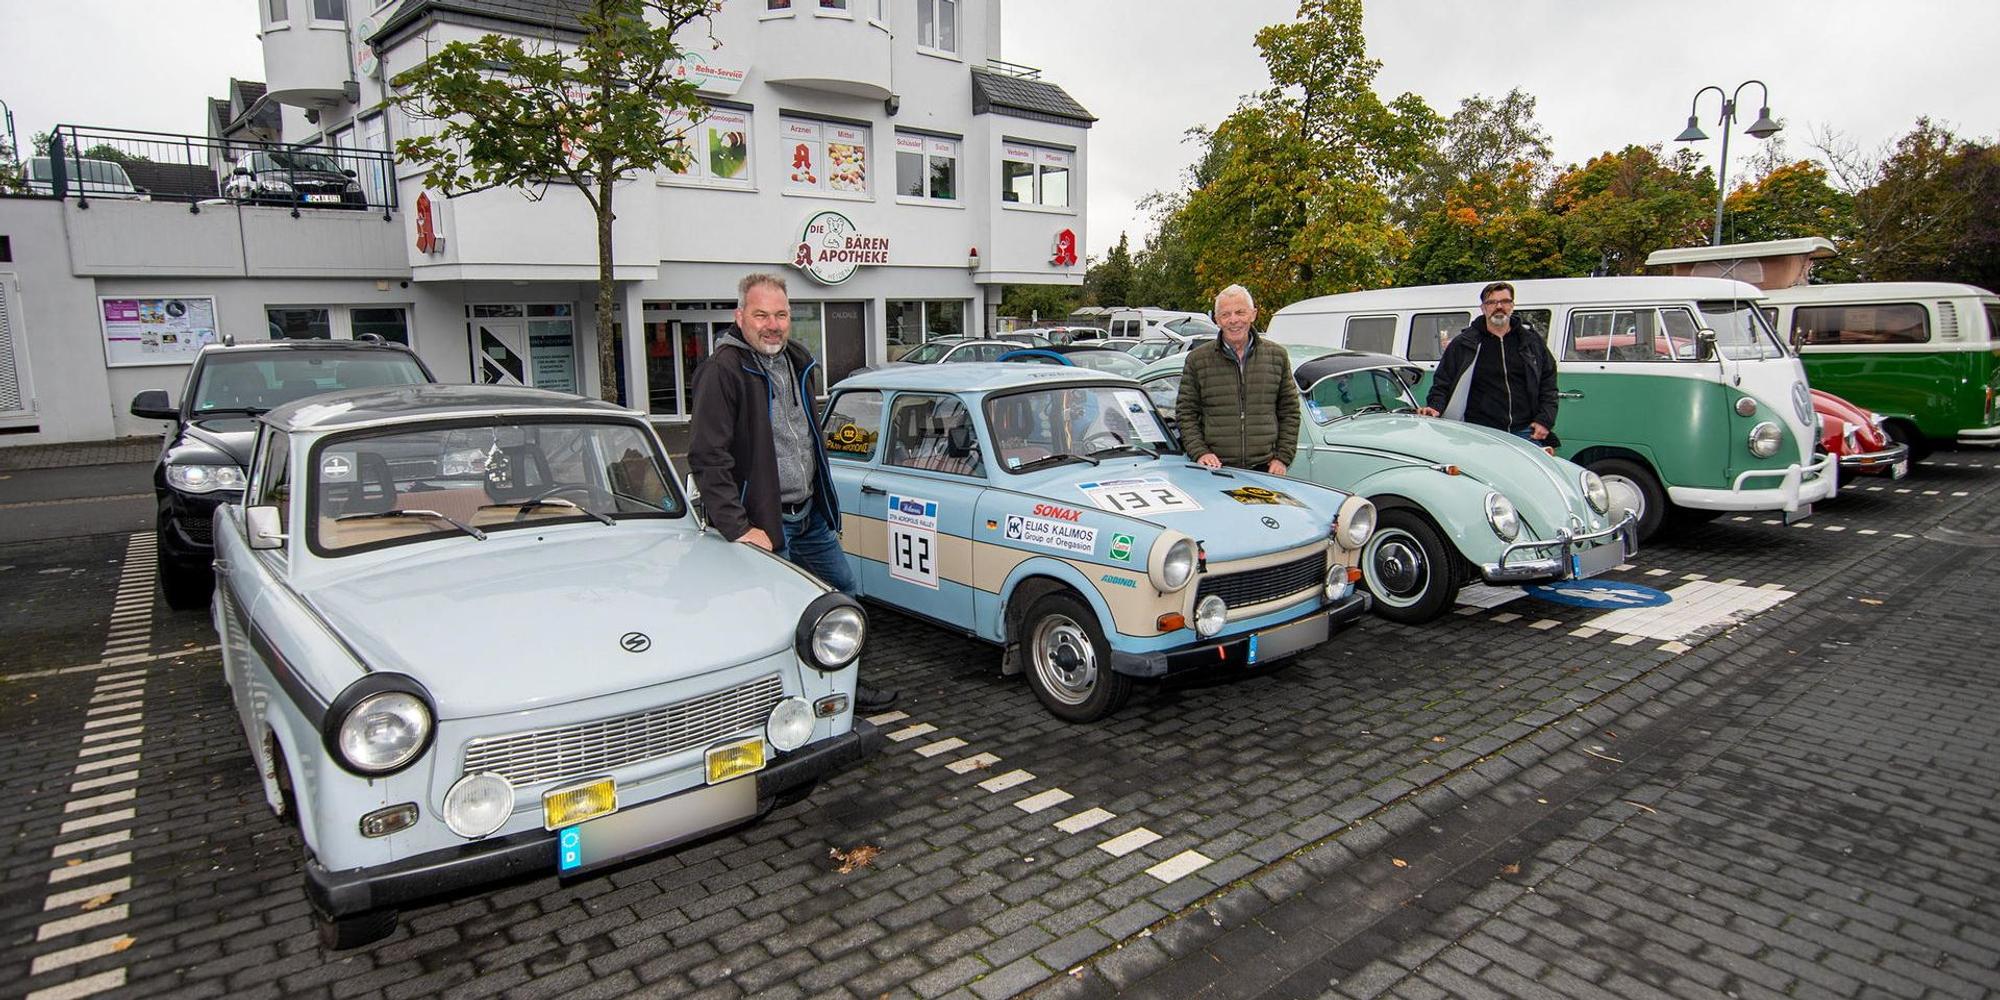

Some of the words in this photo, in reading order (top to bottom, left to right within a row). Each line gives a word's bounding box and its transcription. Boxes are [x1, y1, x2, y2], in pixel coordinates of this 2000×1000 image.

[790, 124, 812, 134] Arznei
[837, 130, 855, 139] Mittel
[810, 225, 824, 234] DIE
[845, 233, 889, 250] BÄREN
[818, 250, 888, 263] APOTHEKE
[1106, 488, 1184, 511] 132
[1033, 504, 1082, 522] SONAX
[1008, 522, 1020, 534] HK
[1025, 520, 1050, 534] ELIAS
[1052, 527, 1094, 542] KALIMOS
[1024, 531, 1044, 544] Group
[1046, 535, 1054, 544] of
[1055, 537, 1092, 552] Oregasion
[894, 531, 930, 575] 132
[1101, 574, 1137, 589] ADDINOL
[566, 851, 576, 862] D
